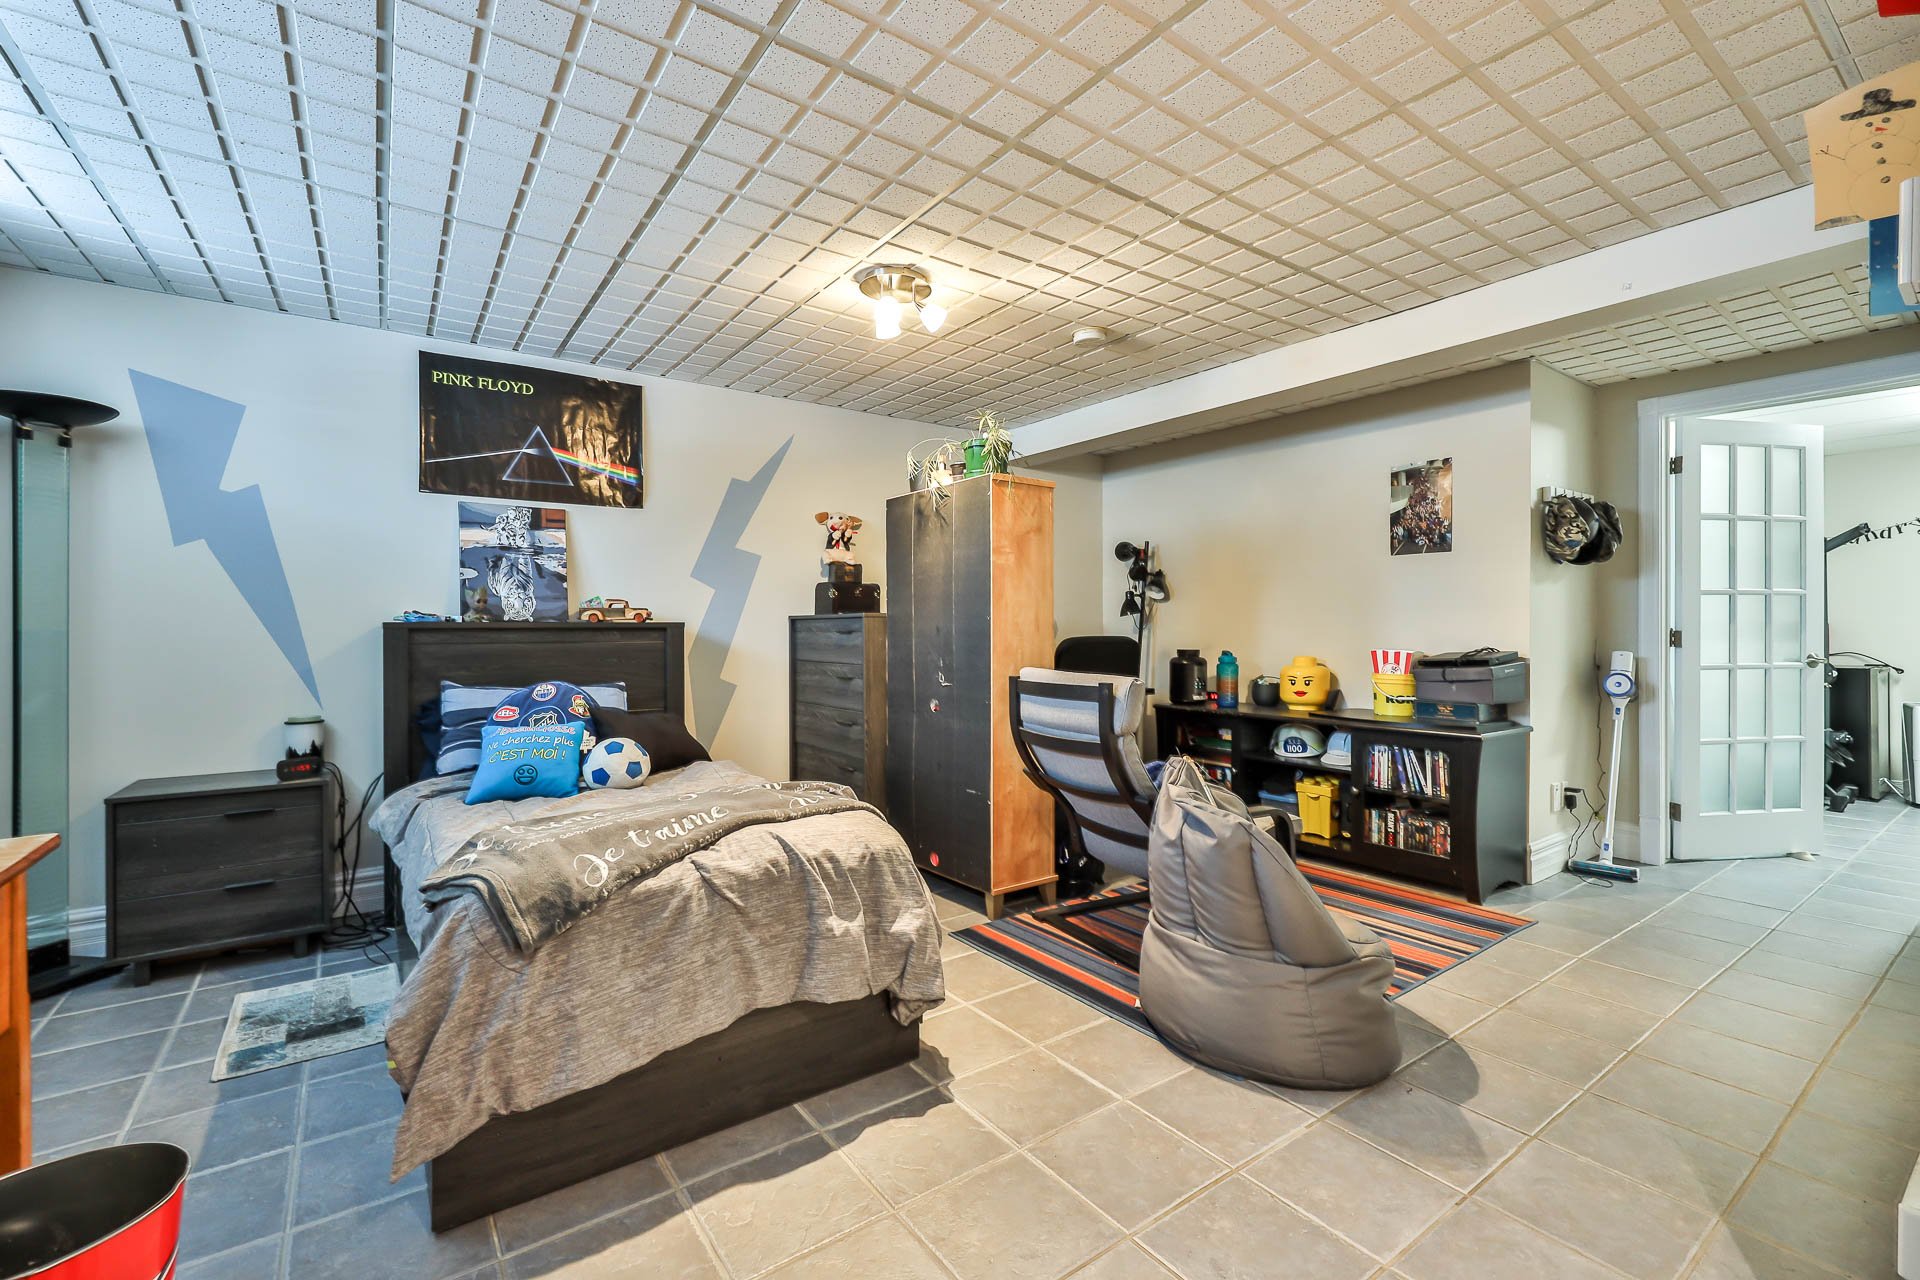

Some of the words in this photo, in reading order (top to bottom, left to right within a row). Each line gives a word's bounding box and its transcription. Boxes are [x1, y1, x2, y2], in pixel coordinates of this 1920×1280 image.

[432, 370, 474, 388] PINK
[477, 376, 534, 395] FLOYD
[502, 734, 551, 746] cherchez
[553, 735, 575, 747] plus
[489, 748, 529, 764] C'EST
[574, 847, 624, 887] Je
[624, 805, 730, 848] t'aime
